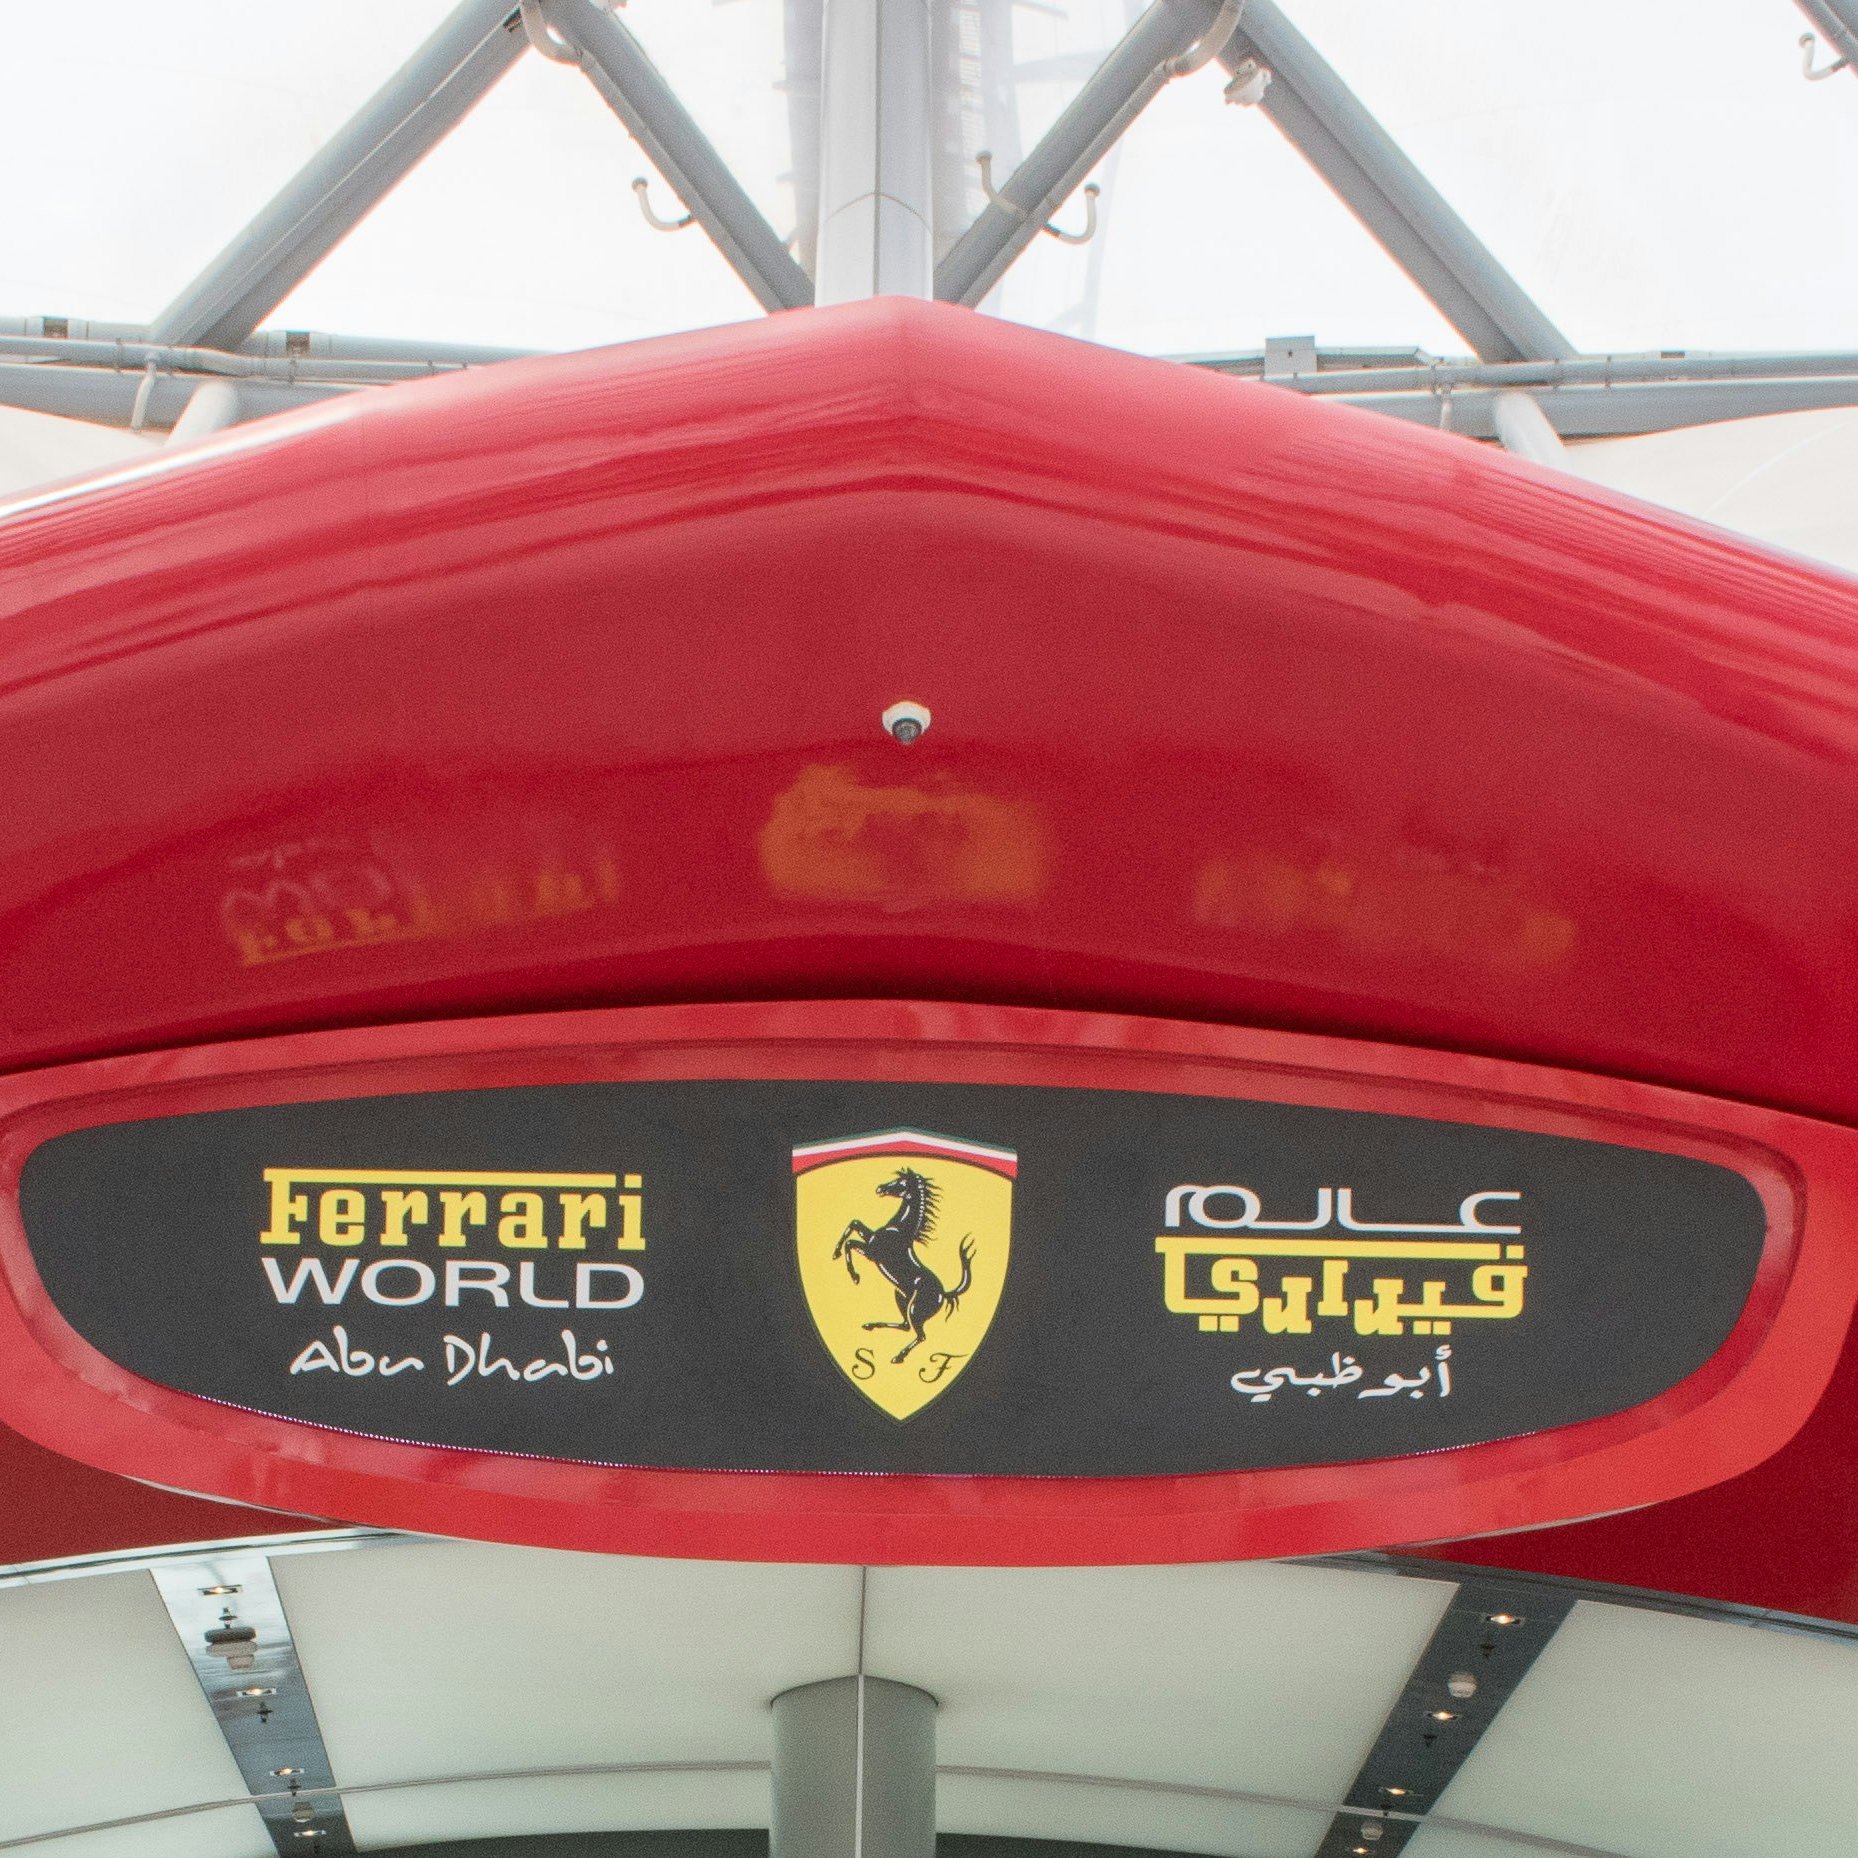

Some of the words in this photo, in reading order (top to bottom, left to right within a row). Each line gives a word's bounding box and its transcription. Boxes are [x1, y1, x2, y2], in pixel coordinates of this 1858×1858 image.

[260, 1168, 645, 1250] Ferrari
[1165, 1184, 1522, 1234] عالم
[260, 1257, 644, 1309] WORLD
[289, 1325, 425, 1377] Abu
[443, 1329, 614, 1387] Dhabi
[851, 1347, 876, 1380] S
